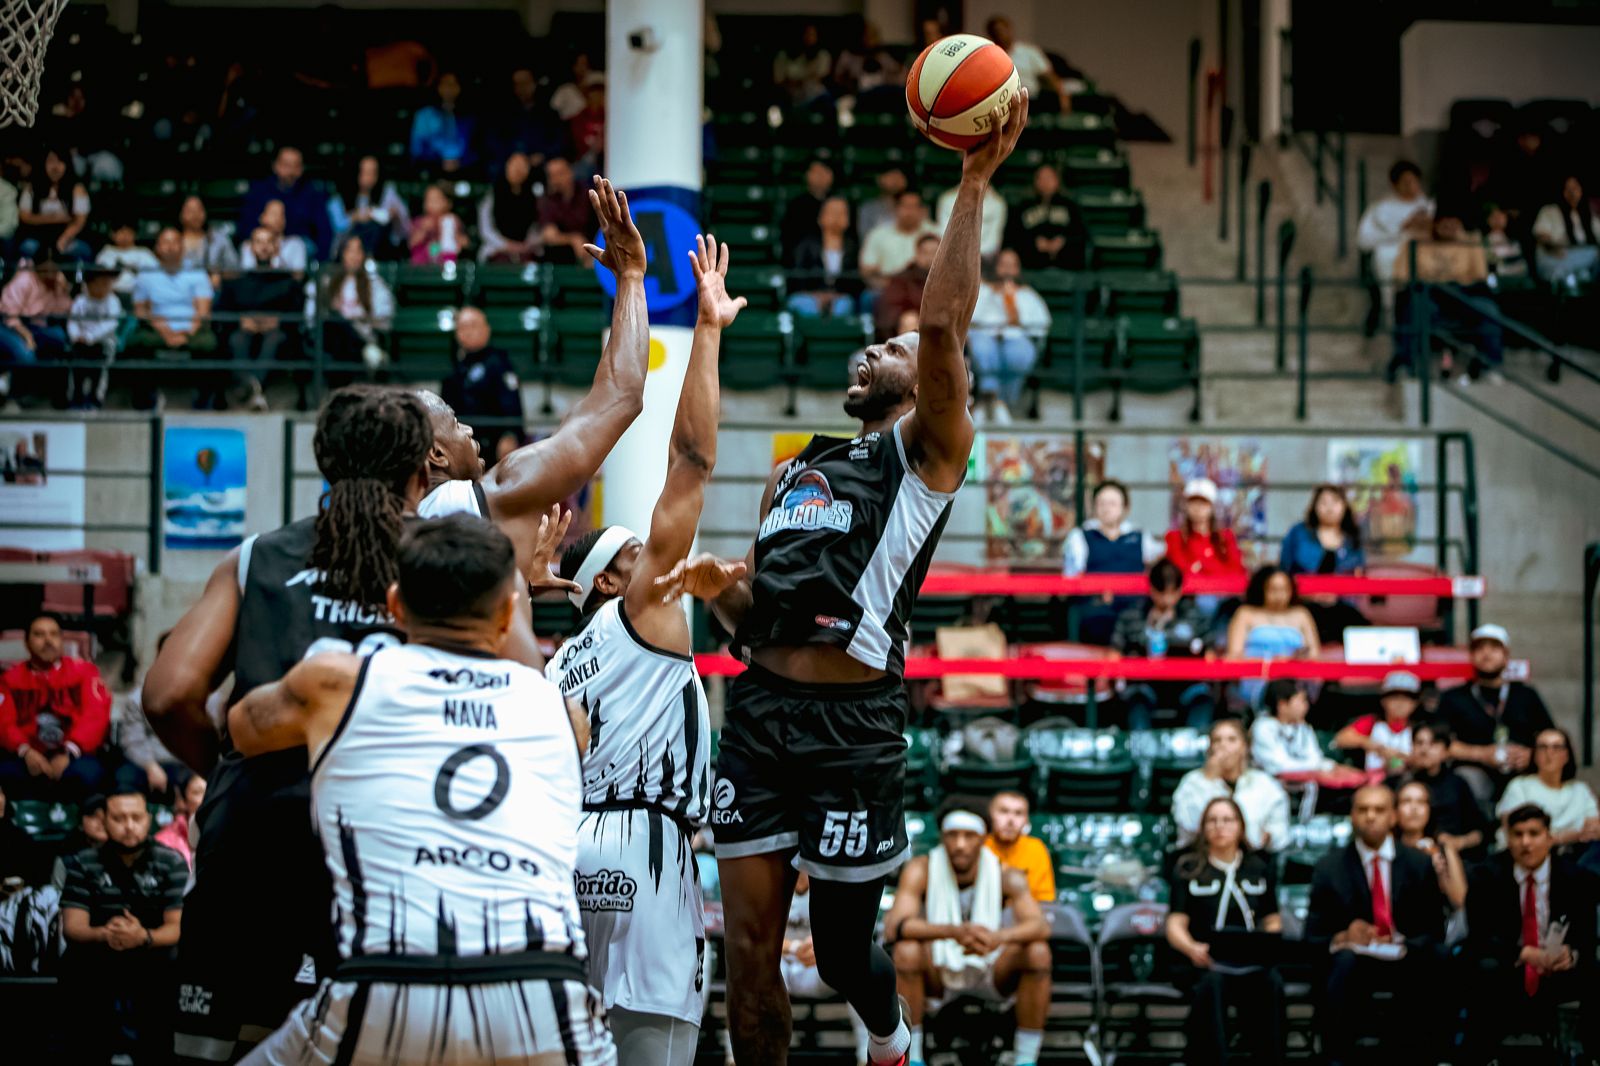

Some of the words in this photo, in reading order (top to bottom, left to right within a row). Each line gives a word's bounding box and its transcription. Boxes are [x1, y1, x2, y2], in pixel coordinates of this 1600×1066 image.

[443, 698, 498, 730] NAVA
[434, 743, 510, 821] 0
[819, 809, 868, 858] 55
